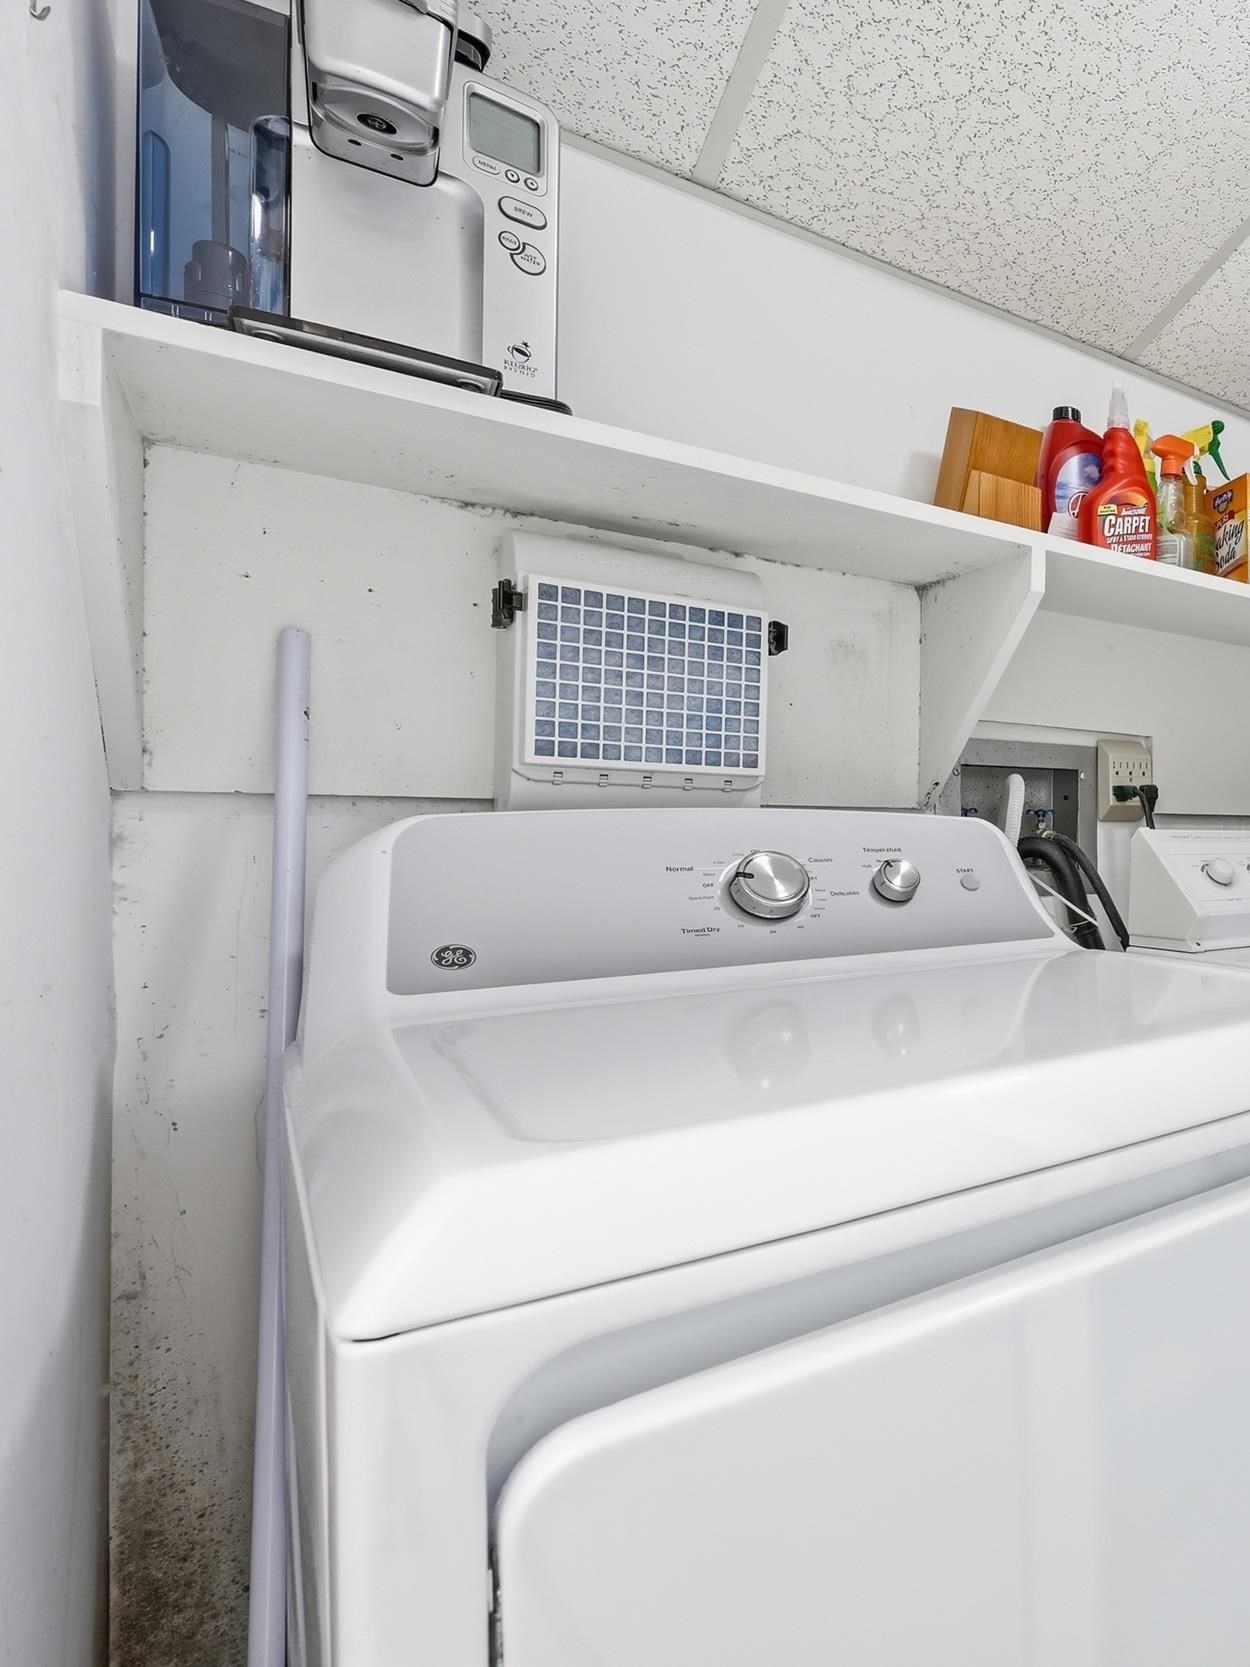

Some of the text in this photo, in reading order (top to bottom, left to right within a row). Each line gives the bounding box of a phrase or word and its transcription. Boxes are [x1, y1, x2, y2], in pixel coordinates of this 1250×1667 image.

[514, 206, 533, 218] BREW
[1103, 515, 1151, 537] CARPET
[1215, 519, 1245, 551] aking
